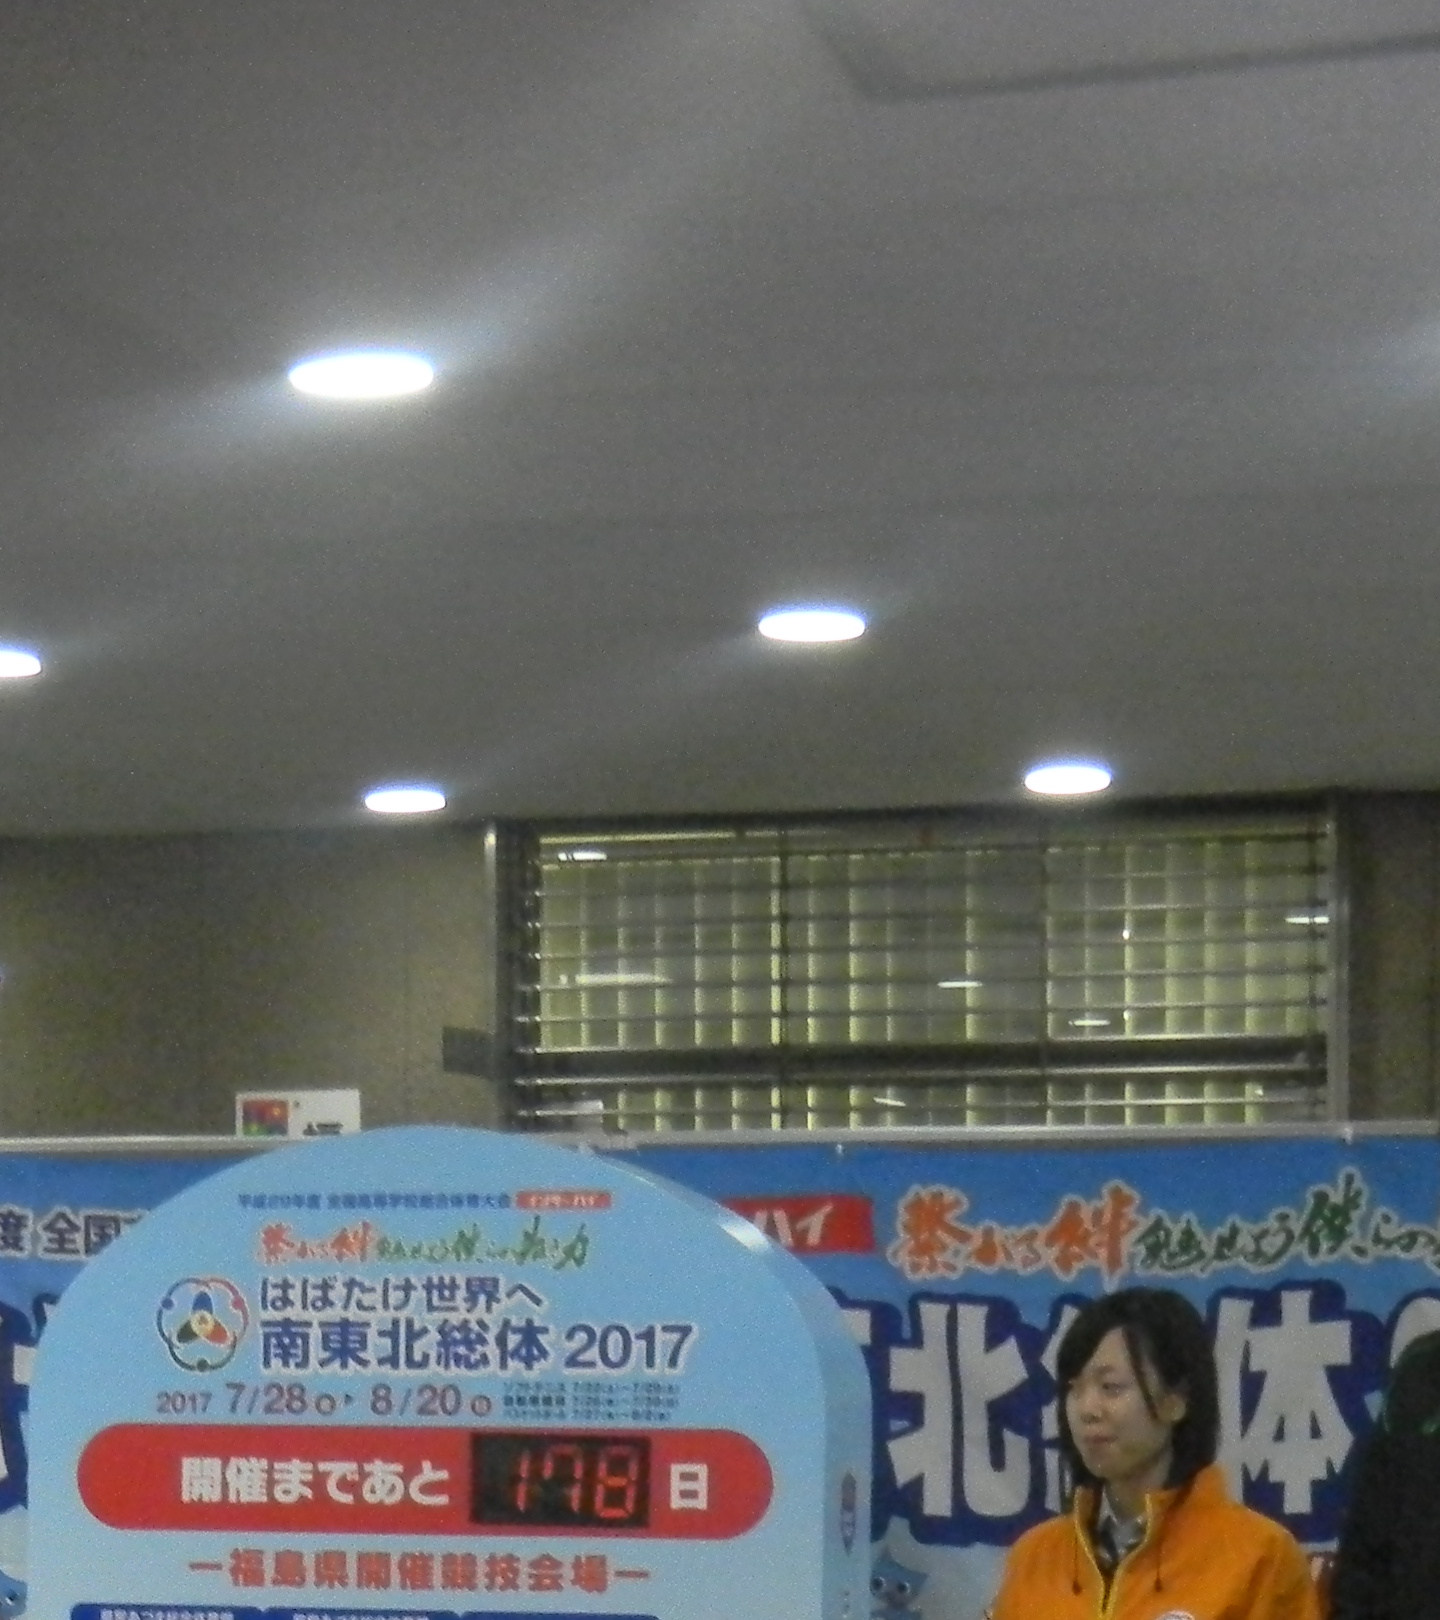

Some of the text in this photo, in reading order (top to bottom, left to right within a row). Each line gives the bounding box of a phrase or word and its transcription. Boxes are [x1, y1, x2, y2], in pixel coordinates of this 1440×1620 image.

[261, 1276, 545, 1312] はばたけ世界へ
[261, 1318, 694, 1371] 南東北総体 2017
[157, 1392, 212, 1415] 2017
[181, 1457, 450, 1507] 開催まであと
[670, 1463, 709, 1511] 日
